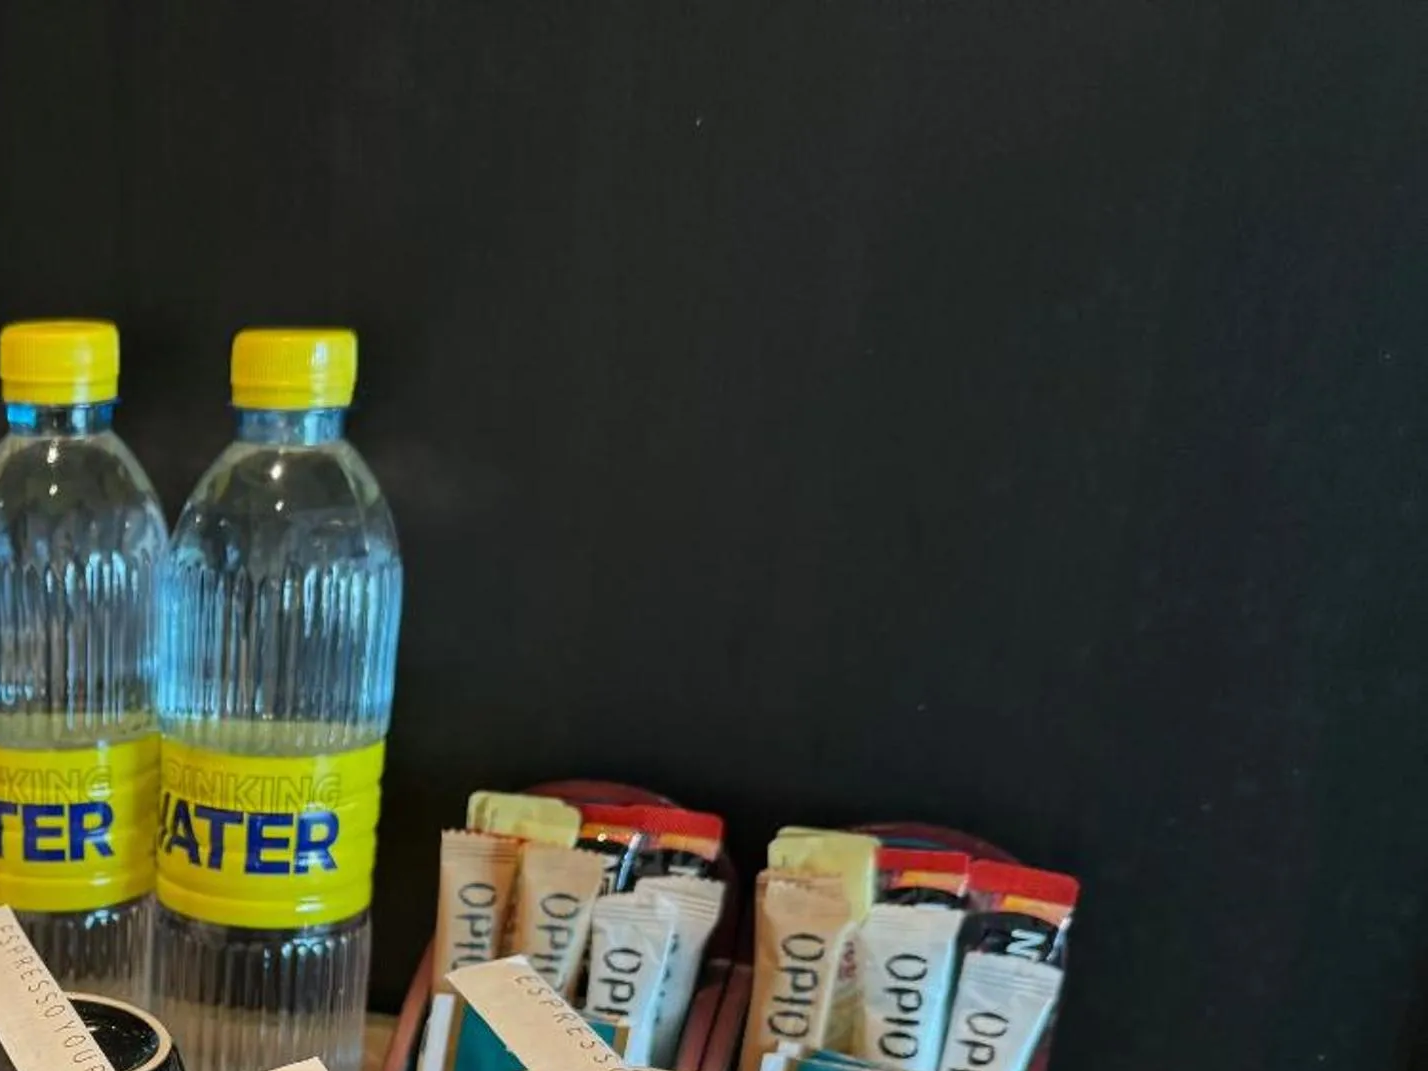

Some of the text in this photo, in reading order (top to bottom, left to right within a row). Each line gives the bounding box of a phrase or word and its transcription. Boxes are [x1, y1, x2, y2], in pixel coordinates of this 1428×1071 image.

[594, 947, 643, 1017] OPI
[768, 933, 825, 1038] OPIO
[879, 954, 928, 1060] OPIO
